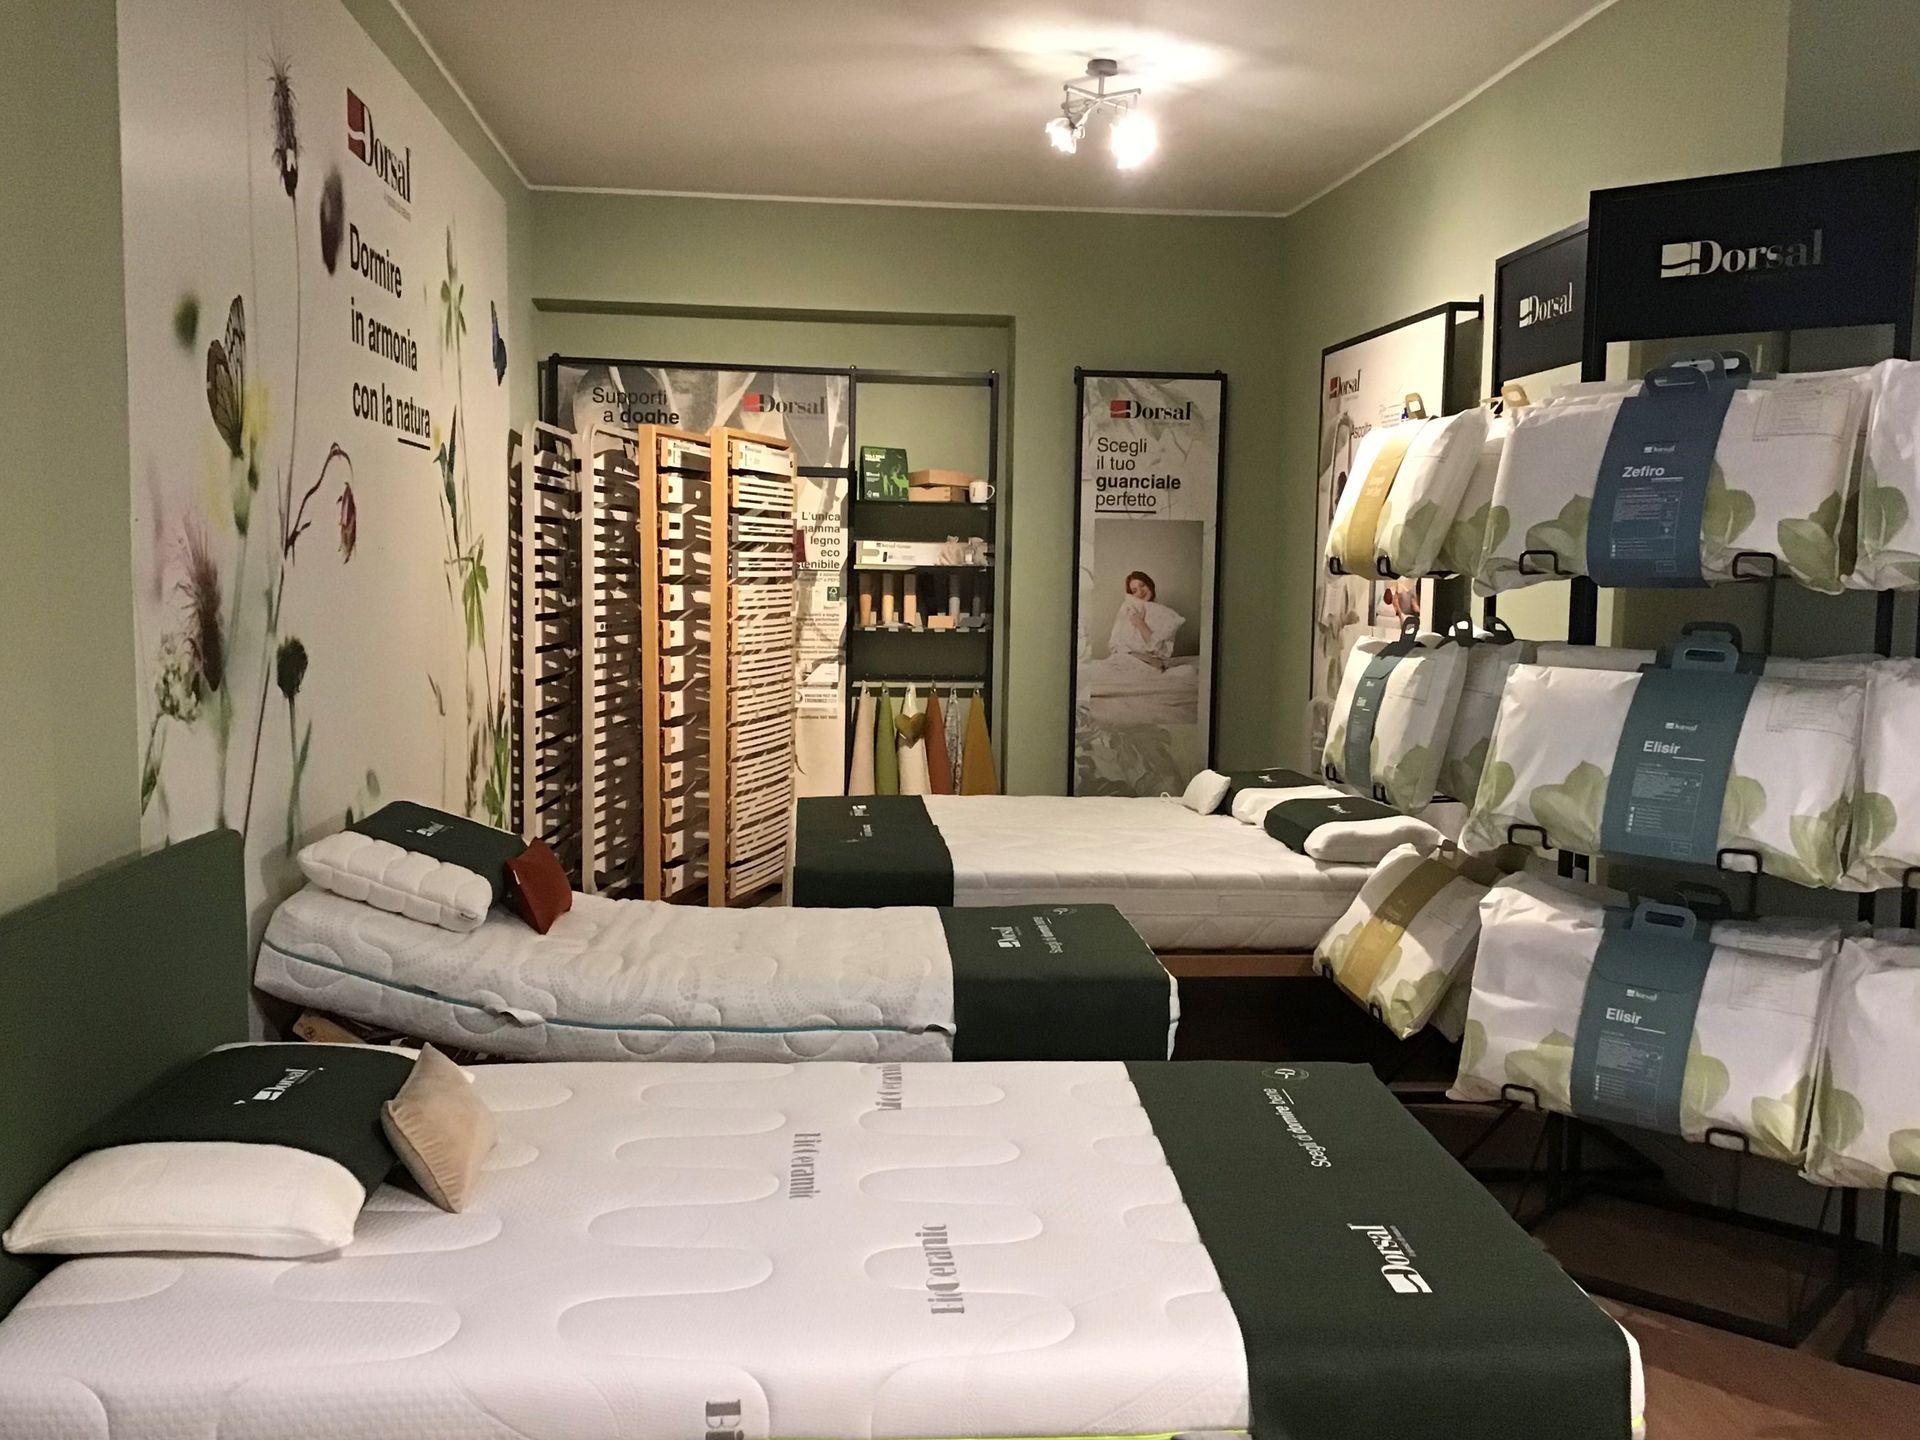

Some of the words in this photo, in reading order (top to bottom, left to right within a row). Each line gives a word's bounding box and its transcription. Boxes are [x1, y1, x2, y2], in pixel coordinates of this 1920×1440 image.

[361, 100, 412, 205] Dorsal
[348, 222, 403, 299] Dormire
[1688, 227, 1825, 276] Dorsal
[1527, 282, 1574, 324] Dorsal
[350, 297, 365, 346] in
[367, 313, 418, 372] armonia
[1337, 368, 1362, 397] Dorsal
[592, 386, 668, 409] Supporti
[758, 393, 826, 415] Dorsal
[352, 380, 379, 423] con
[381, 382, 394, 428] la
[396, 400, 432, 440] natura
[603, 409, 615, 423] a
[620, 408, 680, 425] doghe
[1125, 400, 1193, 421] Dorsal
[1096, 436, 1148, 457] Scegli
[1096, 455, 1104, 471] il
[1110, 456, 1136, 471] tuo
[1621, 465, 1665, 479] Zefiro
[1095, 474, 1181, 492] guanciale
[1095, 491, 1157, 510] perfetto
[801, 511, 841, 522] L'unica
[810, 535, 841, 548] legno
[1642, 740, 1681, 755] Elisir
[1605, 1007, 1643, 1025] Elisir
[1347, 1222, 1427, 1287] Dorsal
